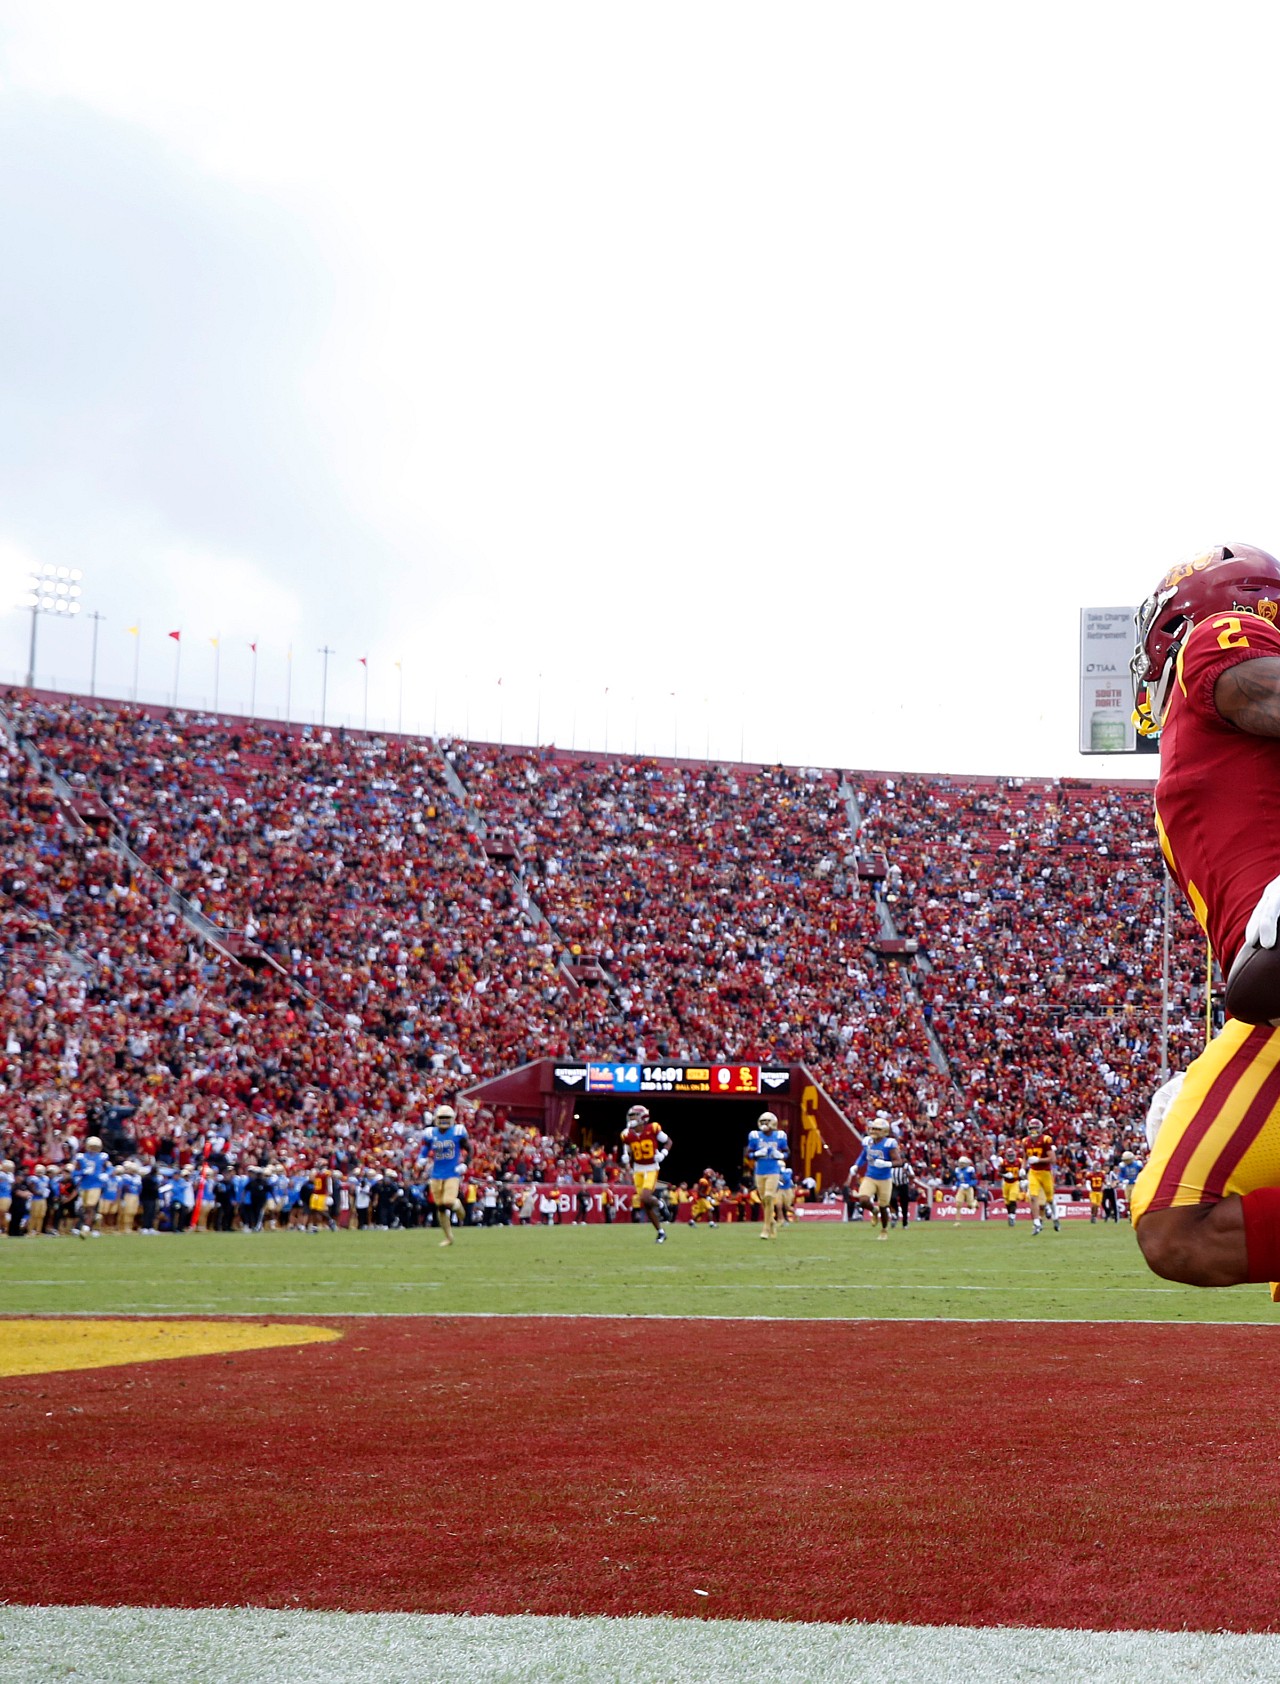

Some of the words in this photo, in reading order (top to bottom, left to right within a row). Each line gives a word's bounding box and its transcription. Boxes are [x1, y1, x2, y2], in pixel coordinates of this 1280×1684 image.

[1087, 632, 1127, 640] Retirement
[1212, 617, 1250, 650] 2
[1095, 689, 1122, 698] SOUTH
[1095, 699, 1121, 707] NORTE
[615, 1066, 638, 1083] 14
[643, 1067, 683, 1082] 14:01
[717, 1067, 731, 1084] 0
[631, 1139, 654, 1161] 89
